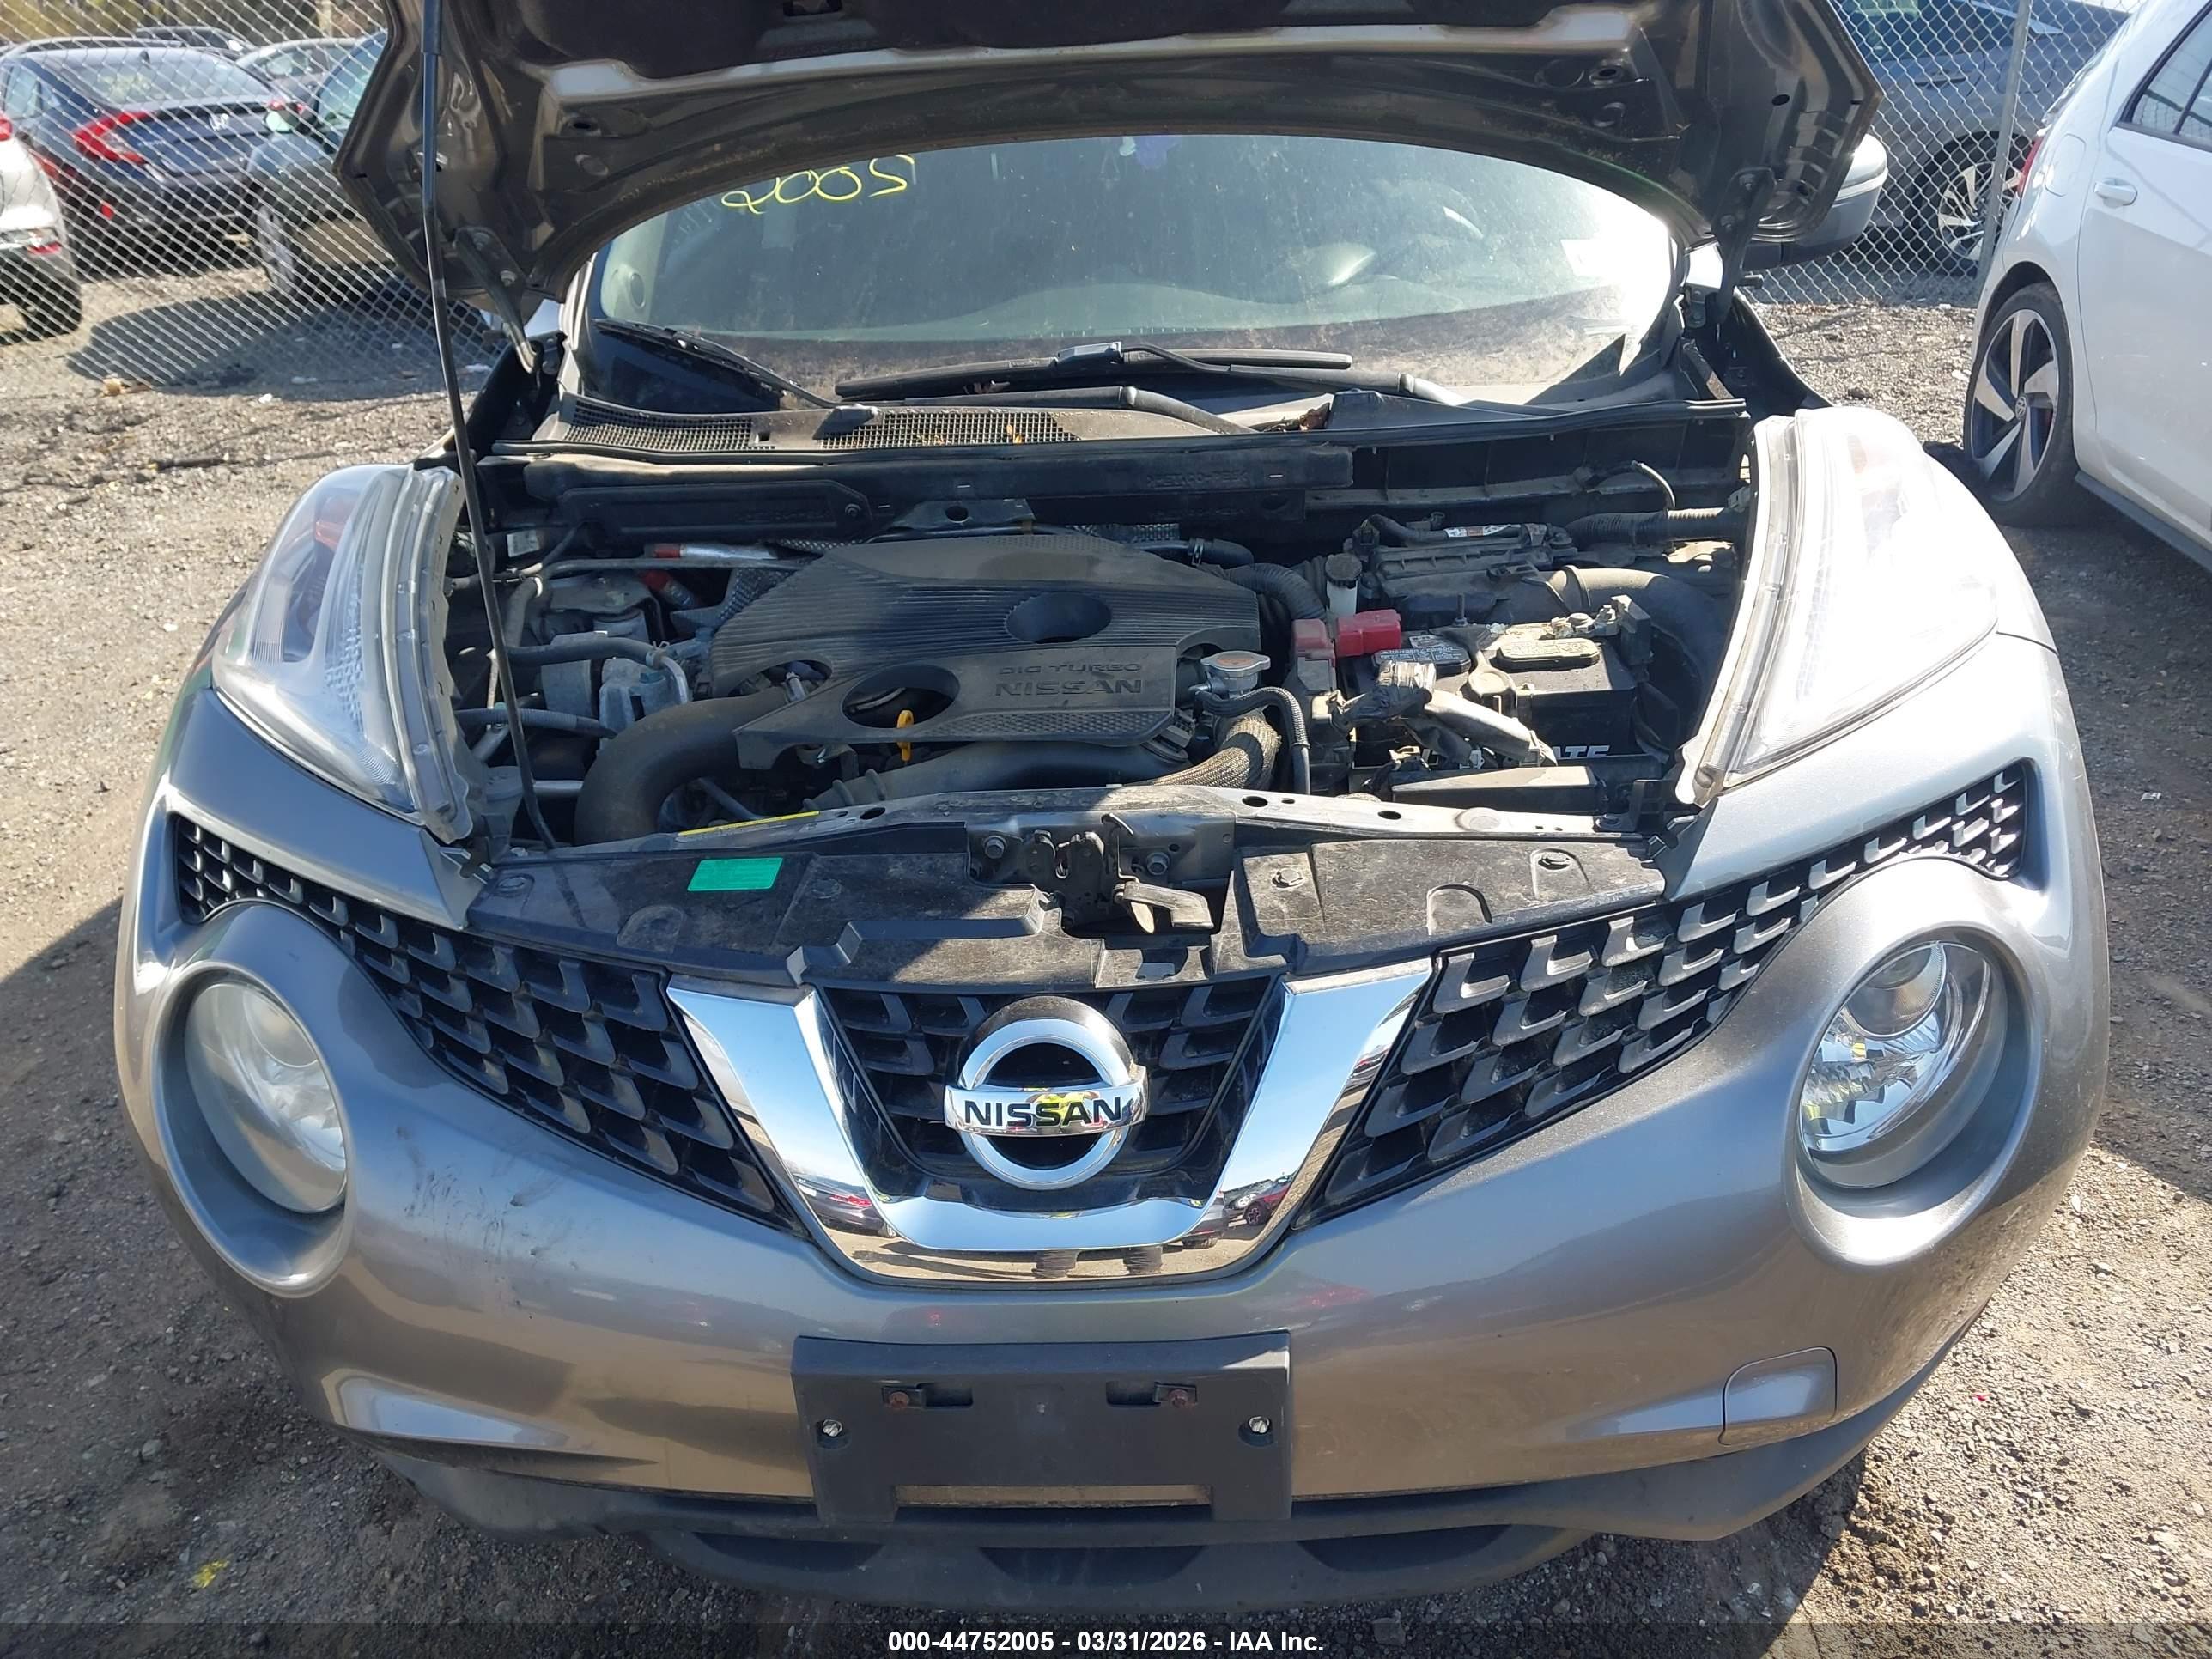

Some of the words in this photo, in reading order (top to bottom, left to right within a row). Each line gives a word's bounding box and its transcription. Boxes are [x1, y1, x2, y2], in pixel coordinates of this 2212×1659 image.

[1049, 664, 1142, 672] TURBO
[995, 679, 1142, 696] NISSAN
[964, 1097, 1121, 1127] NISSAN
